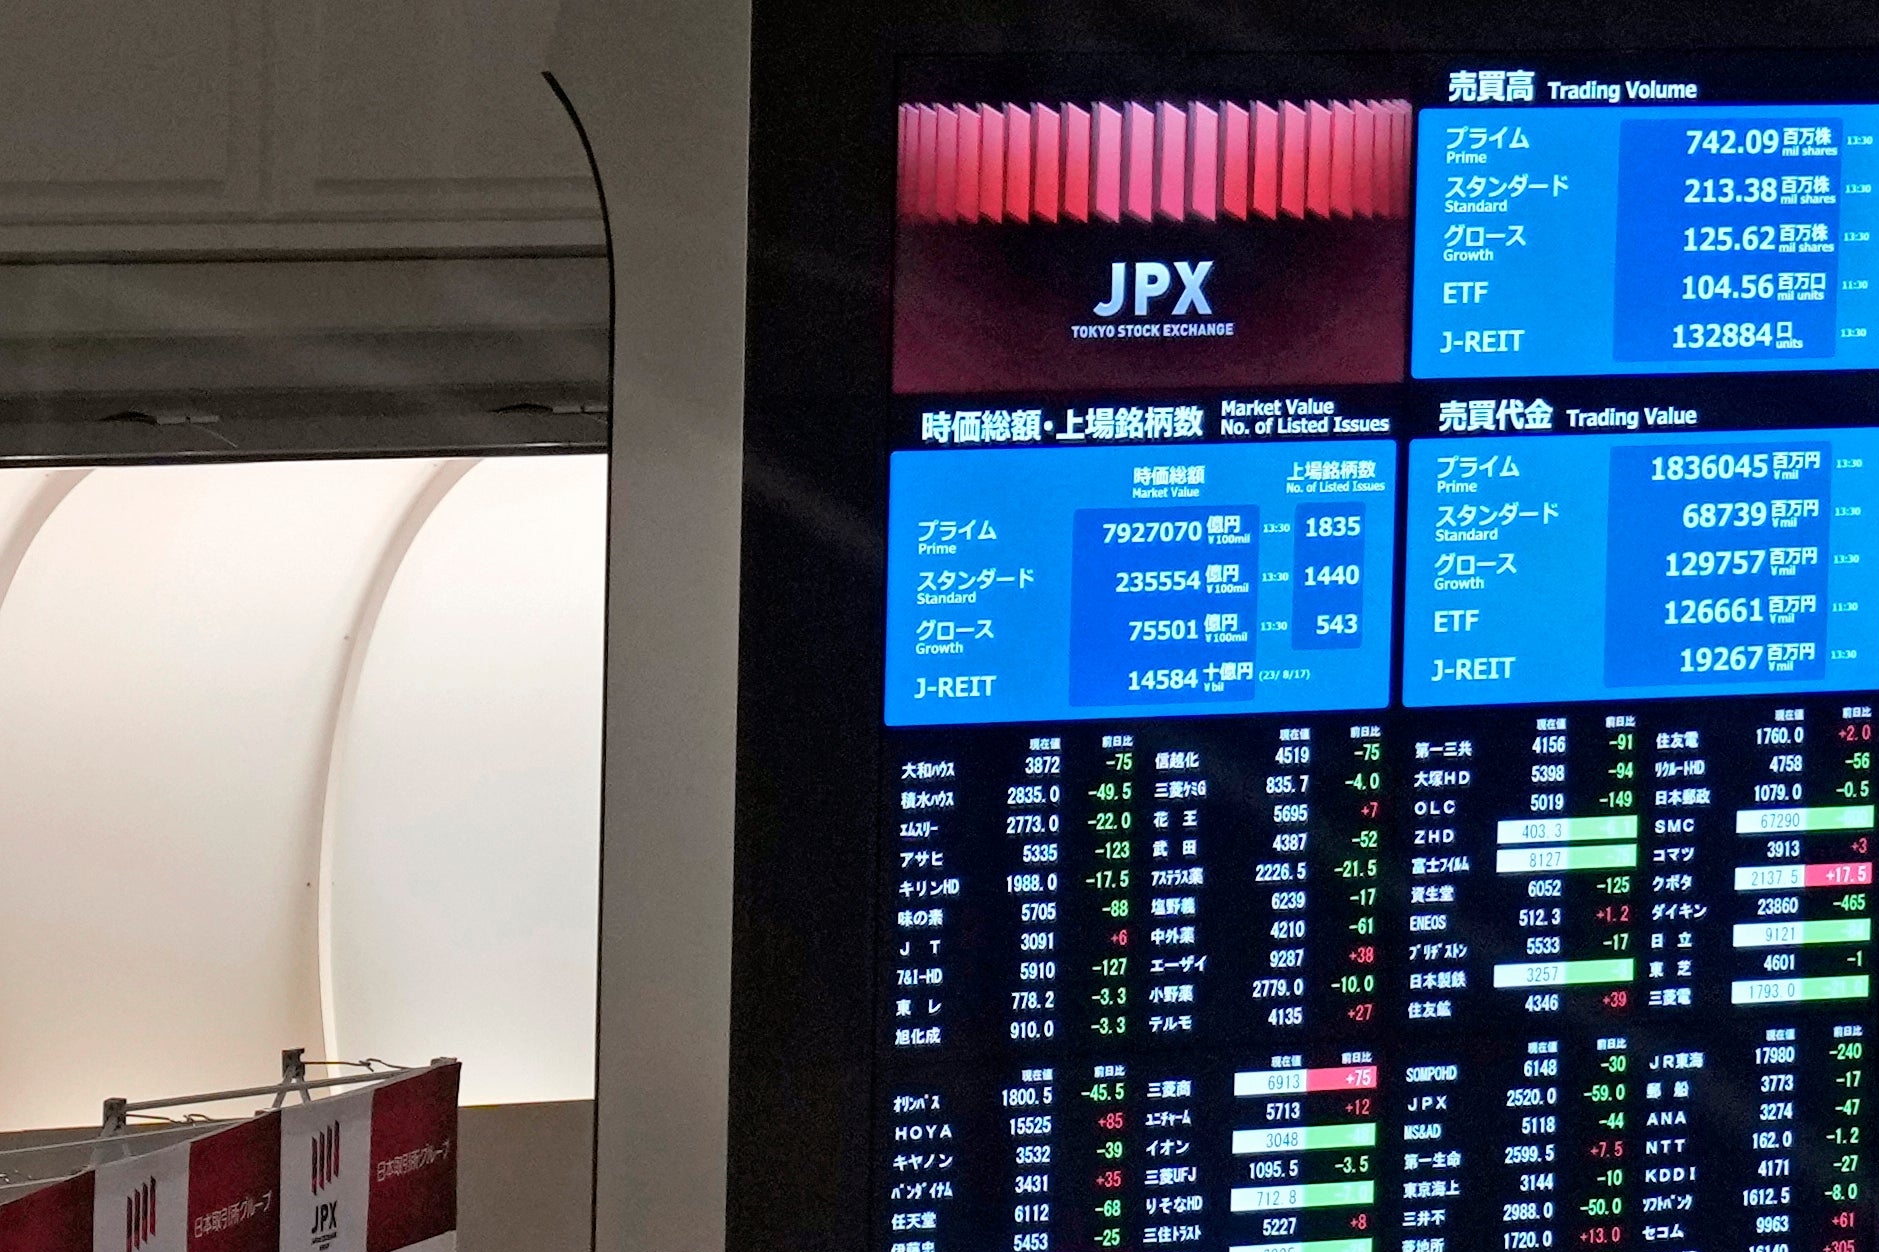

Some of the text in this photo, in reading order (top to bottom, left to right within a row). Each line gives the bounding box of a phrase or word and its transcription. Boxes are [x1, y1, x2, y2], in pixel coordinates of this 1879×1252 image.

[1449, 70, 1697, 103] 売買高 Trading Volume
[1447, 127, 1529, 149] プライム
[1687, 127, 1831, 154] 742.09 百万株
[1446, 175, 1568, 197] スタンダード
[1685, 178, 1777, 202] 213.38
[1445, 225, 1526, 246] グロース
[1684, 226, 1775, 251] 125.62
[1093, 261, 1214, 316] JPX
[1444, 282, 1488, 303] ETF
[1683, 272, 1827, 299] 104.56 百万口
[1441, 330, 1524, 353] J-REIT
[1673, 323, 1772, 348] 132884
[1439, 399, 1697, 431] 売買代金 Trading Value
[1134, 466, 1205, 485] 時価総額
[1287, 461, 1375, 480] 上場銘柄数
[1652, 454, 1767, 480] 1836045
[1683, 502, 1766, 528] 68739
[919, 520, 996, 541] プライム
[1103, 521, 1202, 543] 7927070
[1306, 517, 1360, 537] 1835
[1666, 550, 1765, 576] 129757
[918, 569, 1033, 591] スタンダード
[1116, 571, 1201, 592] 235554
[1305, 565, 1359, 585] 1440
[1435, 610, 1479, 632] ETF
[1665, 598, 1763, 624] 126661
[917, 620, 993, 640] グロース
[1129, 620, 1198, 640] 75501
[1317, 614, 1357, 634] 543
[1432, 657, 1515, 681] J-REIT
[1681, 646, 1763, 672] 19267
[1129, 662, 1253, 690] 14584 十億円
[915, 676, 996, 698] J-REIT
[1532, 736, 1566, 753] 4156
[1025, 753, 1132, 774] 3872 -75
[1023, 843, 1058, 862] 5335
[1767, 840, 1800, 857] 3913
[1528, 879, 1561, 897] 6052
[1021, 902, 1056, 921] 5705
[1758, 897, 1799, 915] 23860
[1270, 920, 1305, 939] 4210
[1410, 914, 1447, 931] ENEOS
[1270, 948, 1304, 967] 9287
[1268, 1007, 1303, 1025] 4135
[1408, 1095, 1556, 1134] JPX 5118
[1010, 1116, 1051, 1135] 15525
[1758, 1158, 1789, 1176] 4171
[311, 1201, 337, 1234] JPX
[1015, 1204, 1049, 1222] 6112
